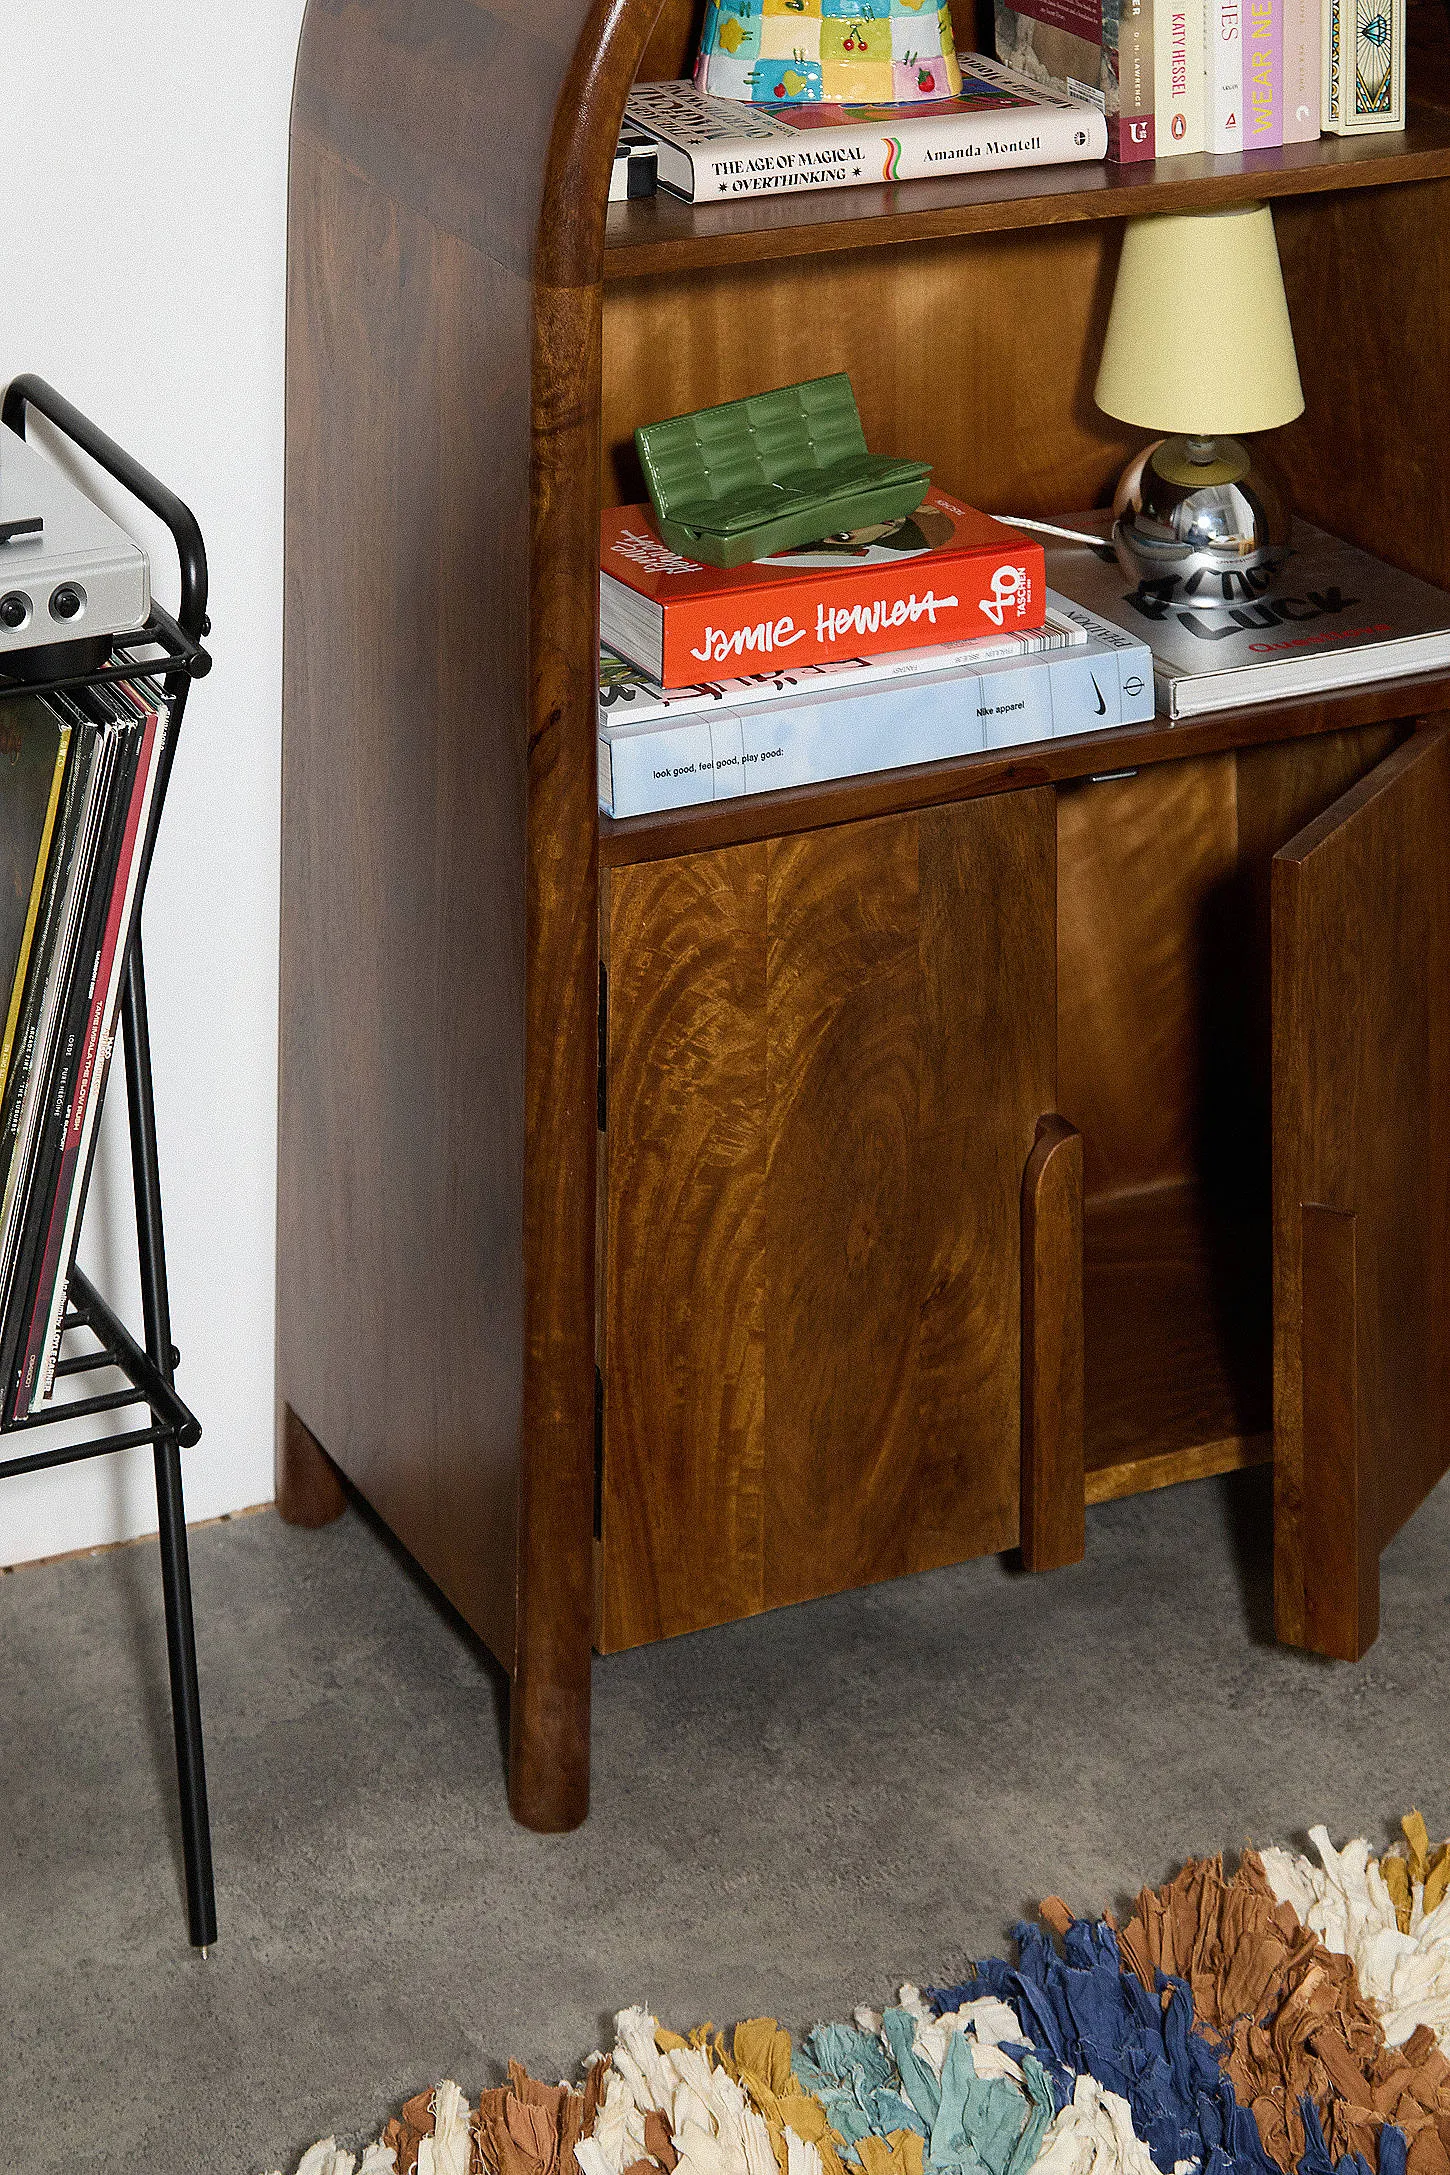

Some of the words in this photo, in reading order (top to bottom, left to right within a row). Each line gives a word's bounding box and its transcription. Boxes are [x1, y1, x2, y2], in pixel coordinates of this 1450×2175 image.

[1172, 13, 1186, 46] KATY
[1133, 58, 1141, 107] LAWRENCE
[1171, 49, 1186, 99] HESSEL
[1252, 50, 1273, 134] WEAR
[711, 160, 744, 176] THE
[746, 155, 777, 174] AGE
[777, 153, 797, 169] OF
[797, 146, 867, 168] MAGICAL
[923, 143, 981, 163] Amanda
[985, 136, 1041, 156] Montell
[732, 167, 847, 192] OVERTHINKING
[1016, 567, 1026, 617] TASCHEN
[1177, 586, 1362, 640] LUCK
[1064, 610, 1133, 649] PHAIDON
[976, 706, 994, 718] Nike
[995, 701, 1025, 716] apparel
[653, 767, 671, 779] look
[673, 762, 697, 778] good,
[699, 759, 714, 771] feel
[716, 756, 740, 771] good,
[742, 750, 758, 764] play
[760, 747, 784, 763] good:
[91, 950, 101, 981] MADISON
[93, 1001, 103, 1026] TAME
[26, 1026, 36, 1053] ARCADE
[66, 1034, 75, 1057] LORDE
[86, 1027, 98, 1060] IMPALA
[22, 1054, 31, 1071] FIRE
[61, 1067, 69, 1084] PURE
[82, 1062, 92, 1078] THE
[54, 1086, 65, 1117] HEROINE
[78, 1079, 89, 1104] SLOW
[73, 1105, 84, 1131] RUSH
